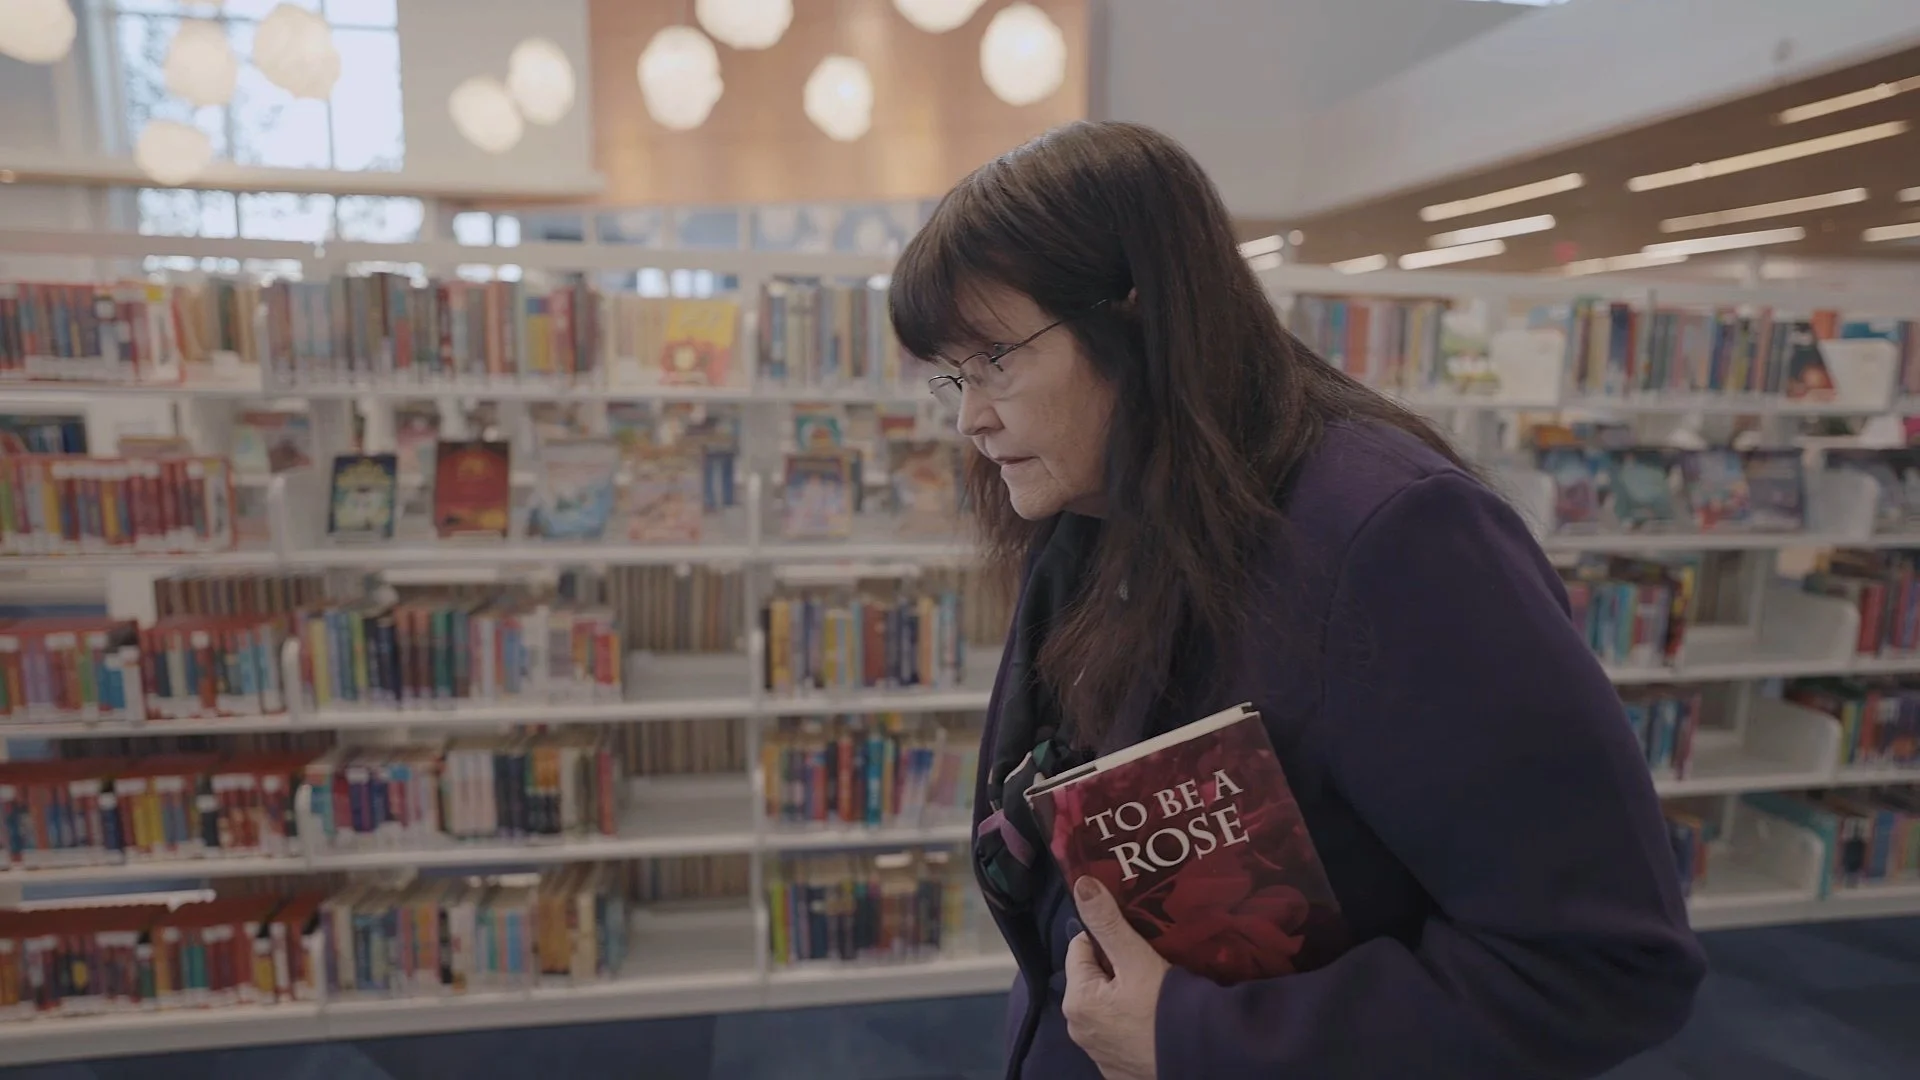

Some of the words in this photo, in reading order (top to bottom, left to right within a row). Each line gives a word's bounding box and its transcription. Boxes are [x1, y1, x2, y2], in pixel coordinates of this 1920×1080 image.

[1085, 801, 1148, 841] TO
[1153, 780, 1205, 819] BE
[1212, 769, 1243, 800] A
[1109, 803, 1250, 881] ROSE
